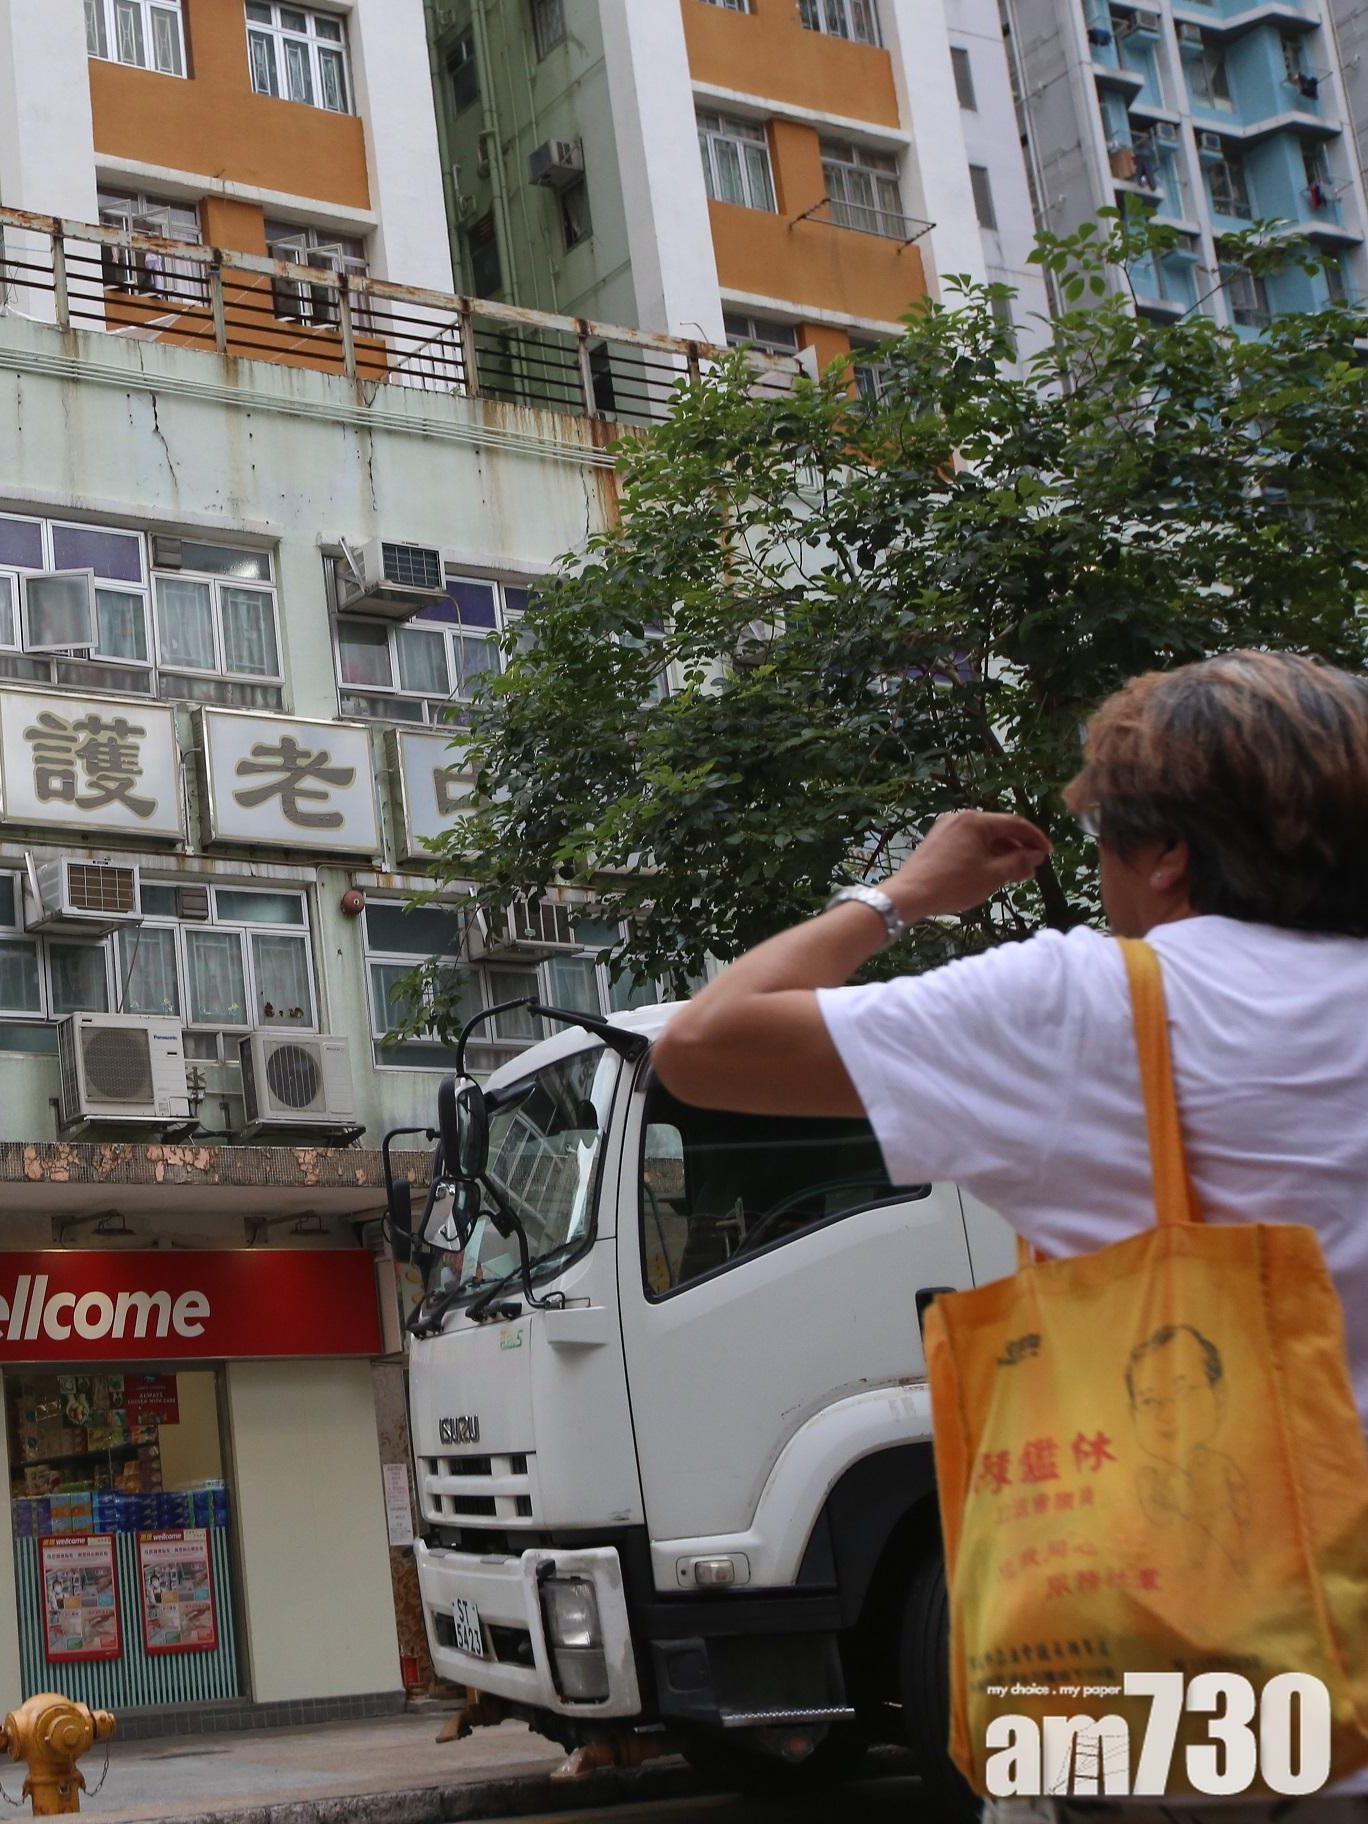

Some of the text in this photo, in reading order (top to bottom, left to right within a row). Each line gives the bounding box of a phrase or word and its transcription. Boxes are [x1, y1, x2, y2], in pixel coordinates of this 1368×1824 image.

[439, 1416, 481, 1445] ISUZU
[457, 1598, 470, 1626] ST
[457, 1623, 482, 1655] 5423
